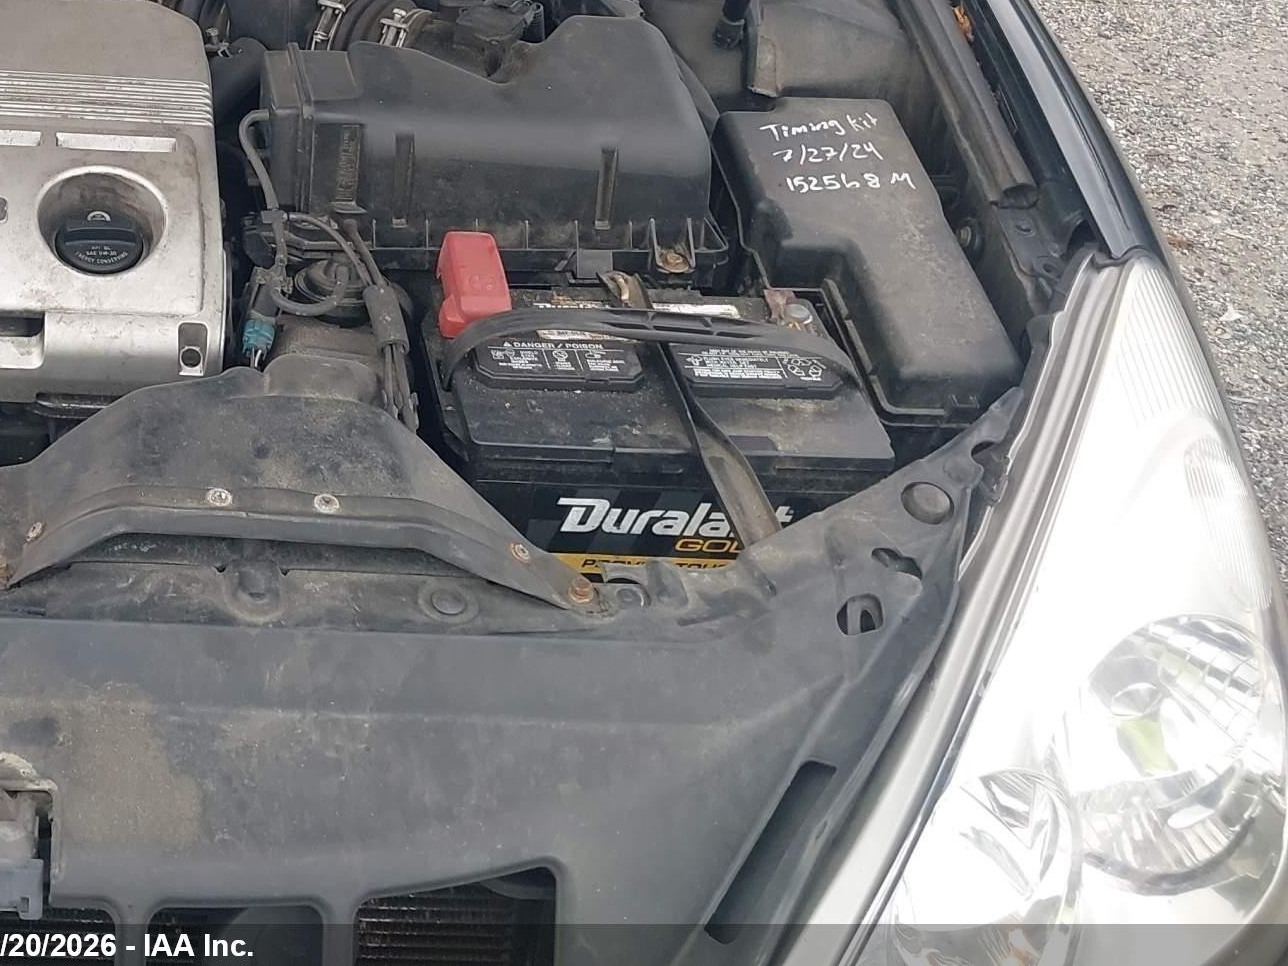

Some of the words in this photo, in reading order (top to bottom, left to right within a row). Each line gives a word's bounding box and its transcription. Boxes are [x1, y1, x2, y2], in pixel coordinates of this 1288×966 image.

[772, 140, 885, 166] 7/27/24
[513, 342, 555, 350] DANGER
[674, 538, 742, 554] GOL
